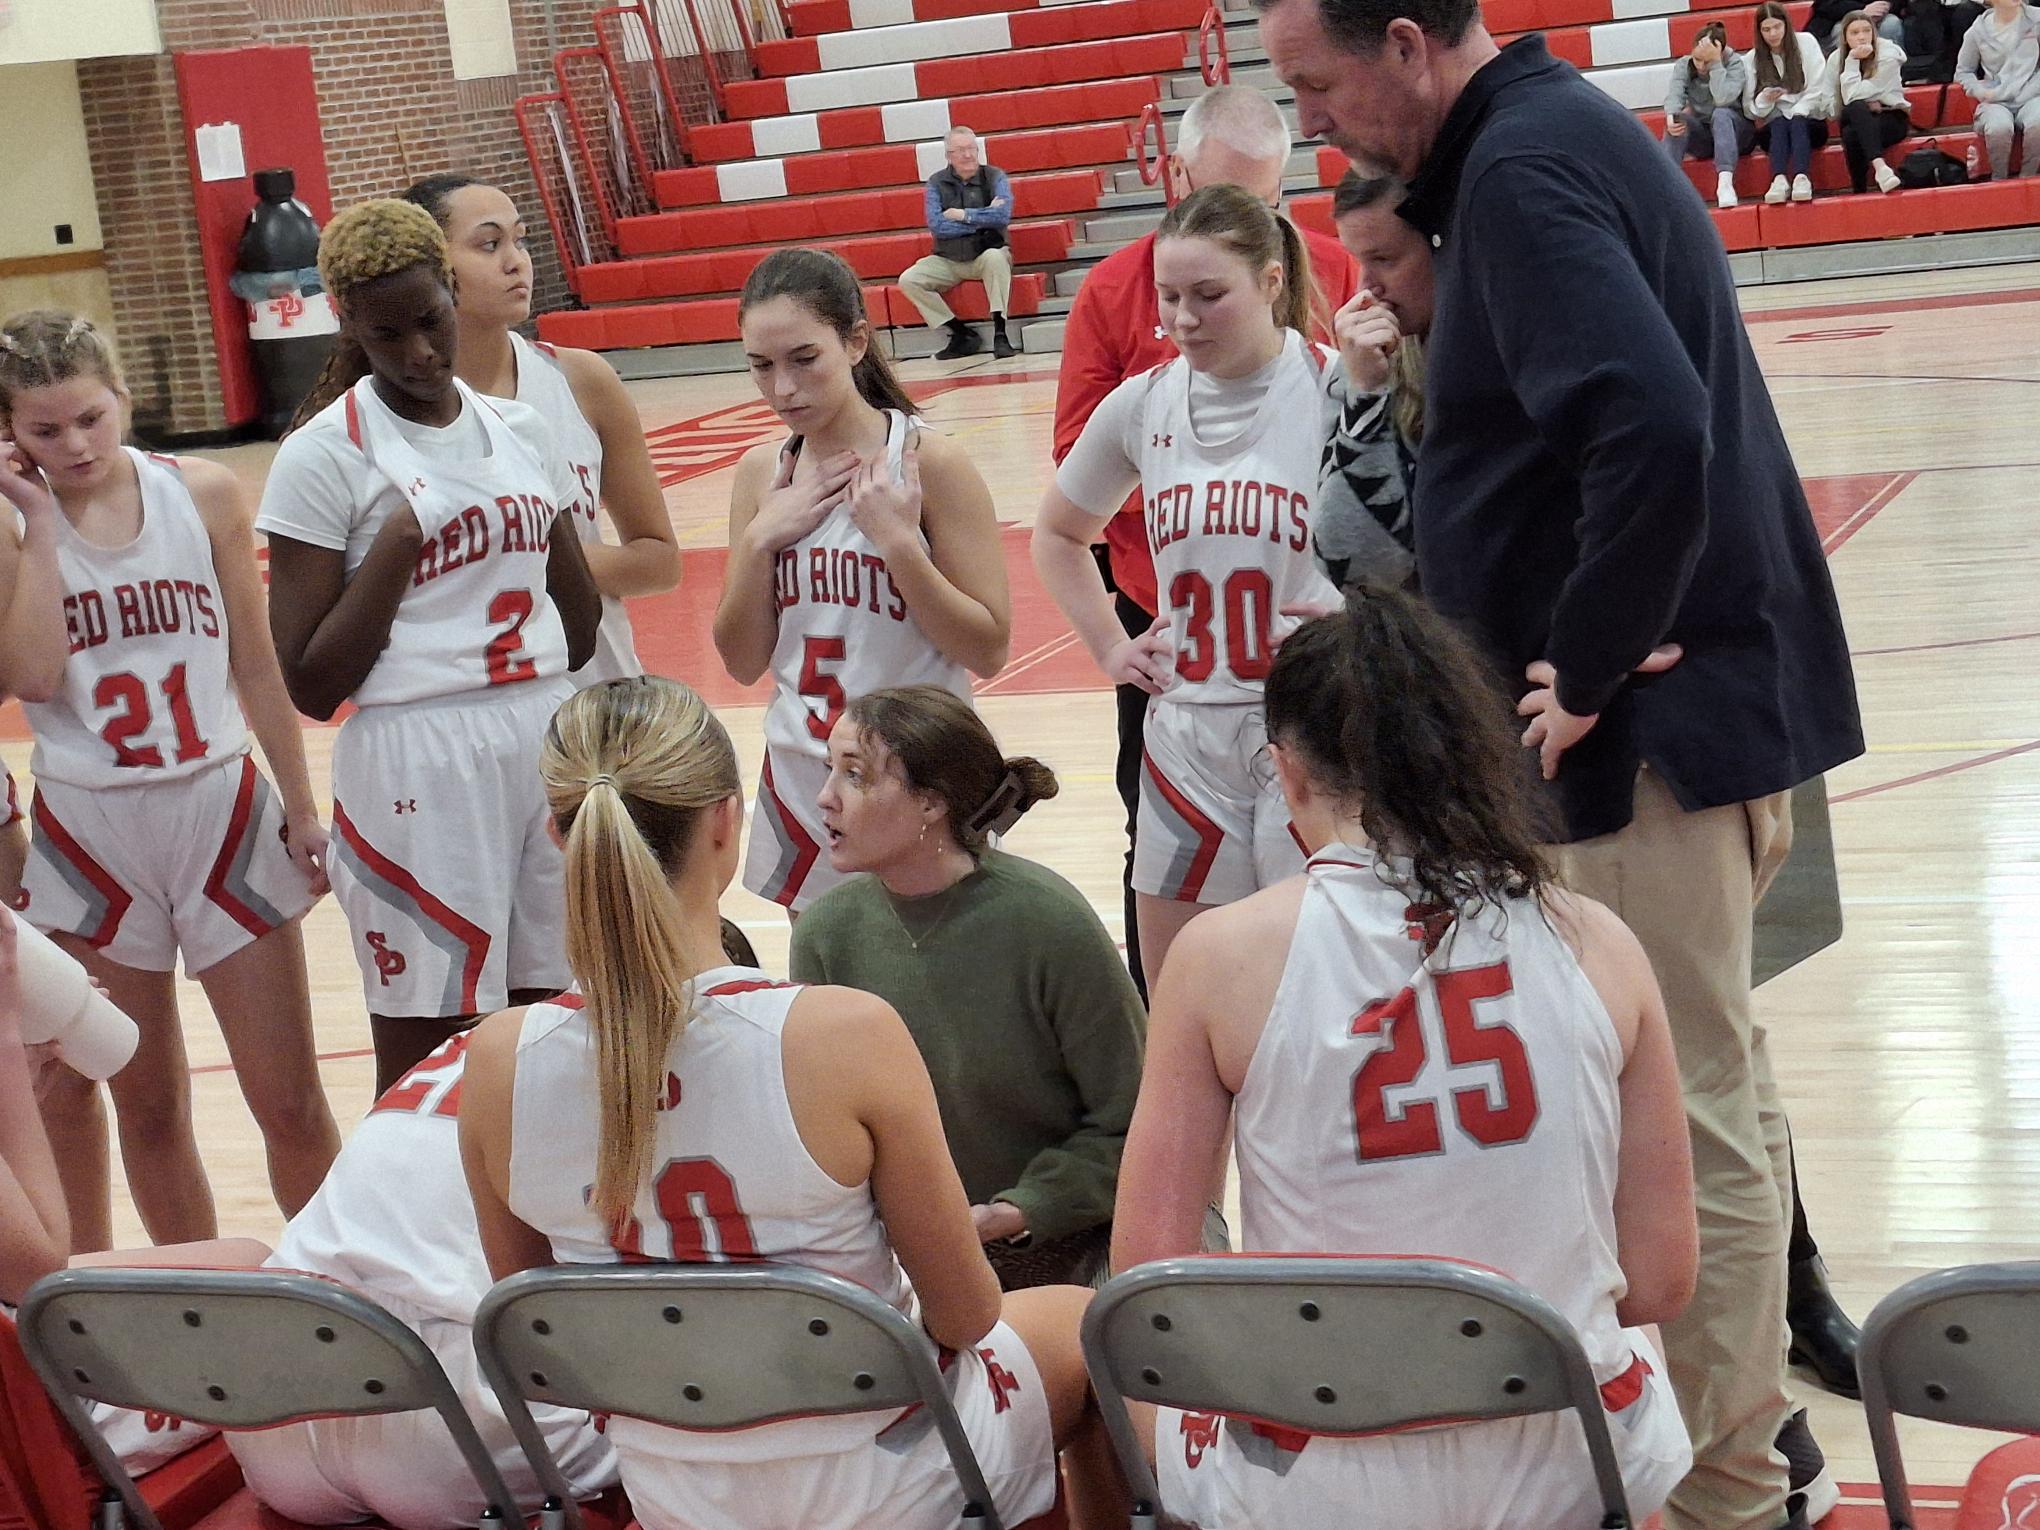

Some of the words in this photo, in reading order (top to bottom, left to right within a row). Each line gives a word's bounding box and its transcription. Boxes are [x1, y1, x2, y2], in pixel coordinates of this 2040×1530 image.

[1149, 486, 1192, 555] RED
[1203, 480, 1308, 553] RIOTS
[63, 590, 108, 655] ED
[113, 579, 219, 638] RIOTS
[484, 587, 538, 686] 2
[810, 547, 907, 623] RIOTS
[1168, 567, 1273, 684] 30
[92, 660, 209, 769] 21
[798, 633, 847, 742] 5
[1347, 954, 1541, 1165] 25
